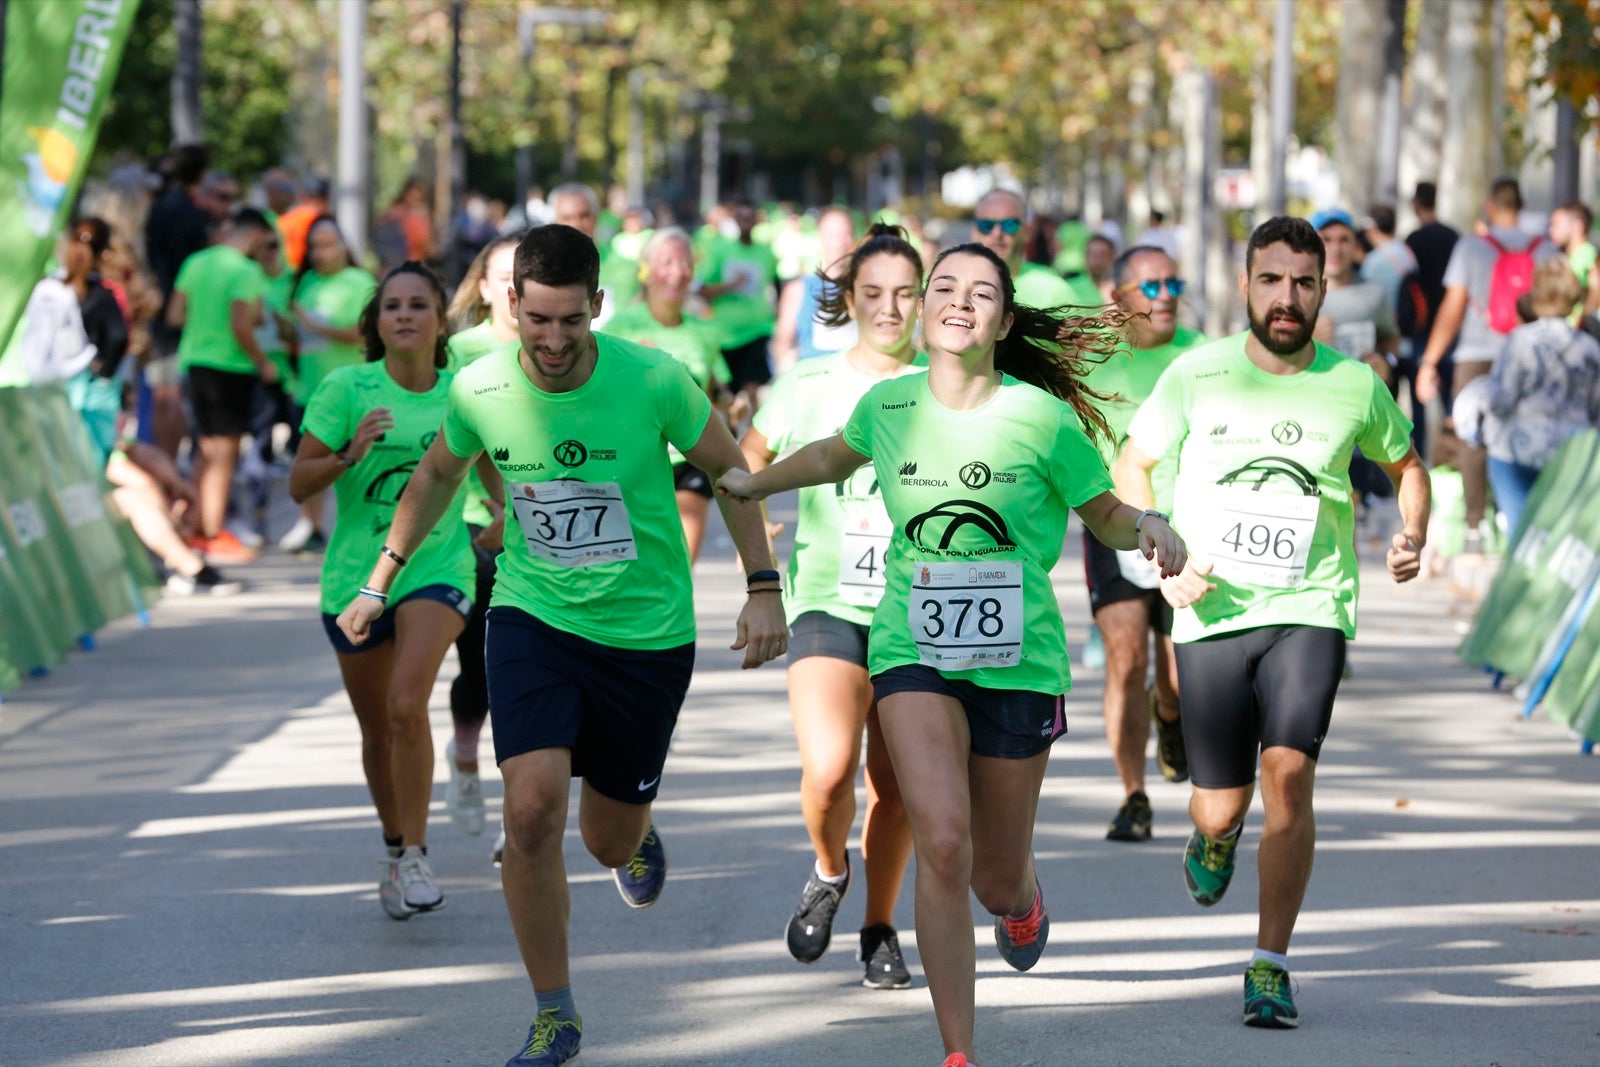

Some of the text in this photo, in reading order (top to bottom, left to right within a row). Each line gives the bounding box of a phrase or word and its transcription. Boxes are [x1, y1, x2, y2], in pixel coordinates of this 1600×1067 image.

[882, 402, 908, 410] luanvi
[901, 478, 948, 487] IBERDROLA
[993, 476, 1017, 484] MUJER
[532, 506, 608, 541] 377
[974, 546, 1016, 556] IGUALDAD
[1221, 522, 1296, 559] 496
[855, 546, 888, 580] 4
[921, 598, 1004, 638] 378
